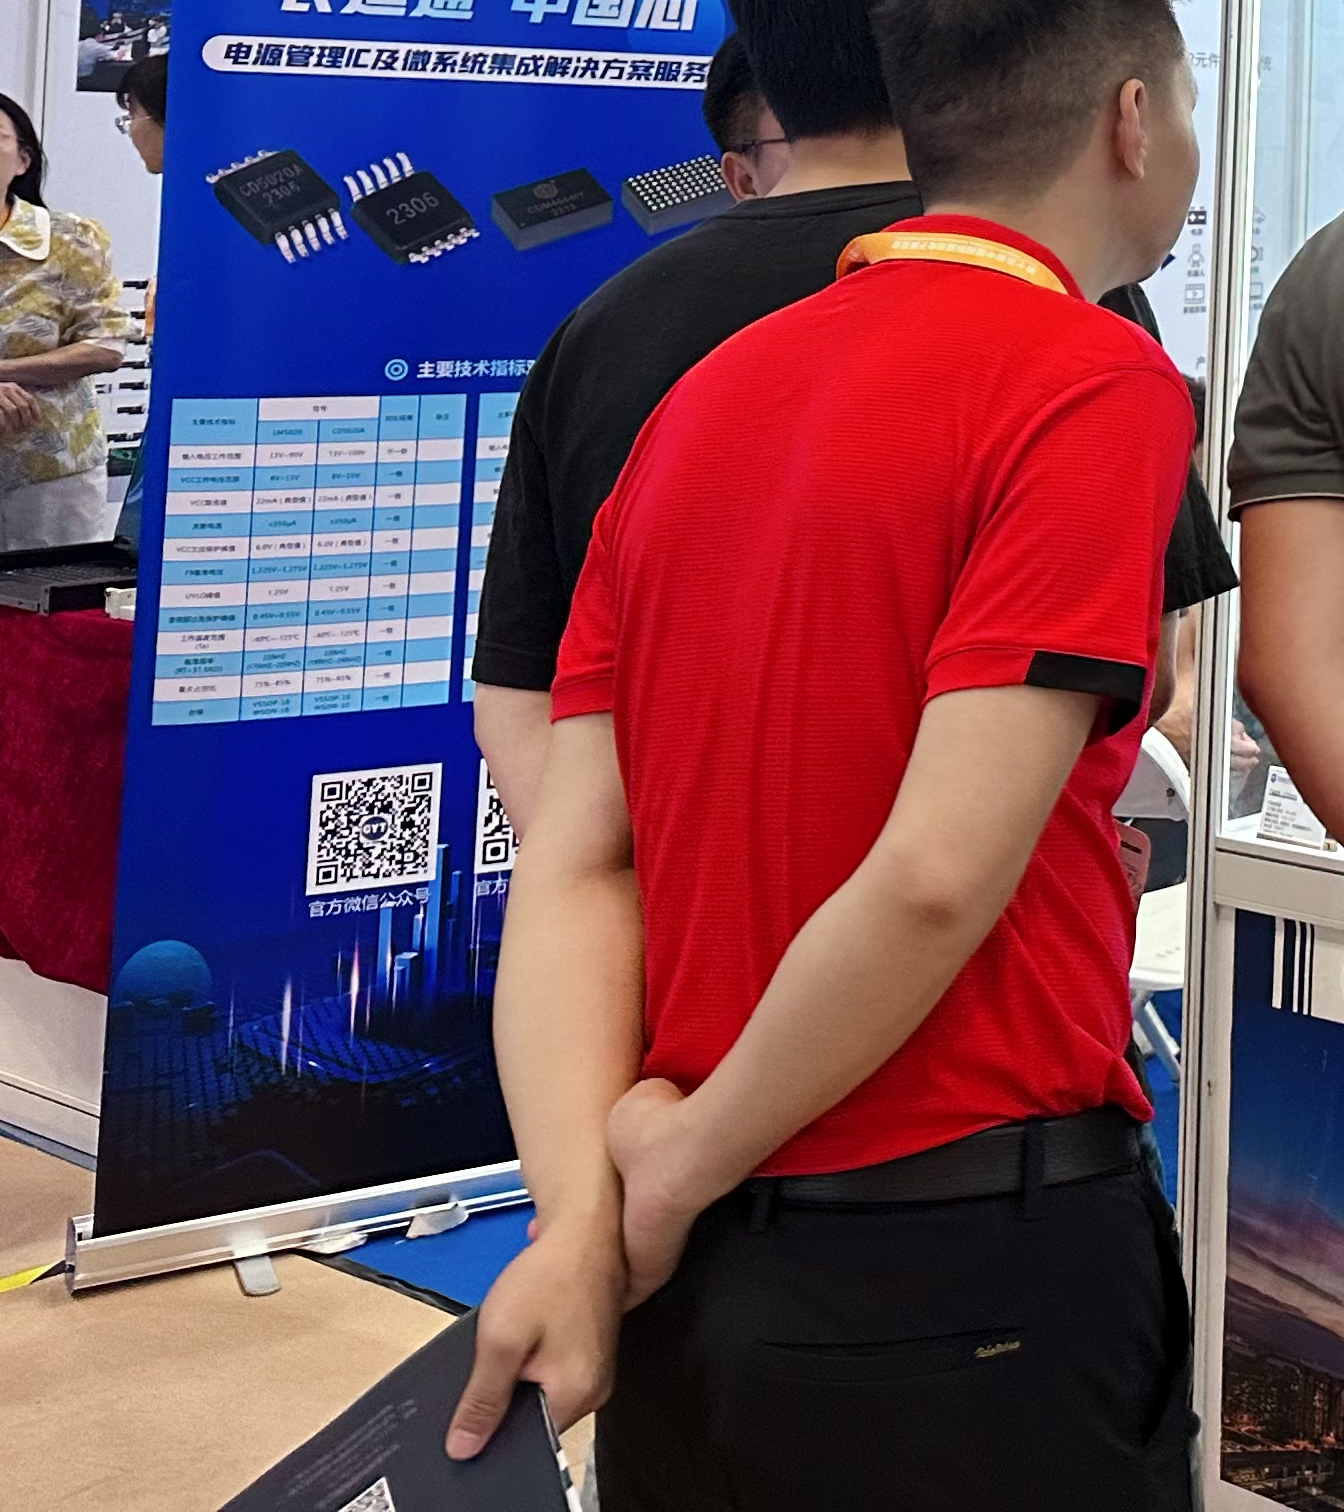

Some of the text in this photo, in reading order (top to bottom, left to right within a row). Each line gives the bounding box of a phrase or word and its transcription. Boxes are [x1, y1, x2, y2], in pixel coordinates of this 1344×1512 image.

[222, 40, 710, 85] 电源管理IC及微系统集成解决方案服务
[385, 191, 440, 226] 2306
[309, 886, 432, 918] 官方微信公众号
